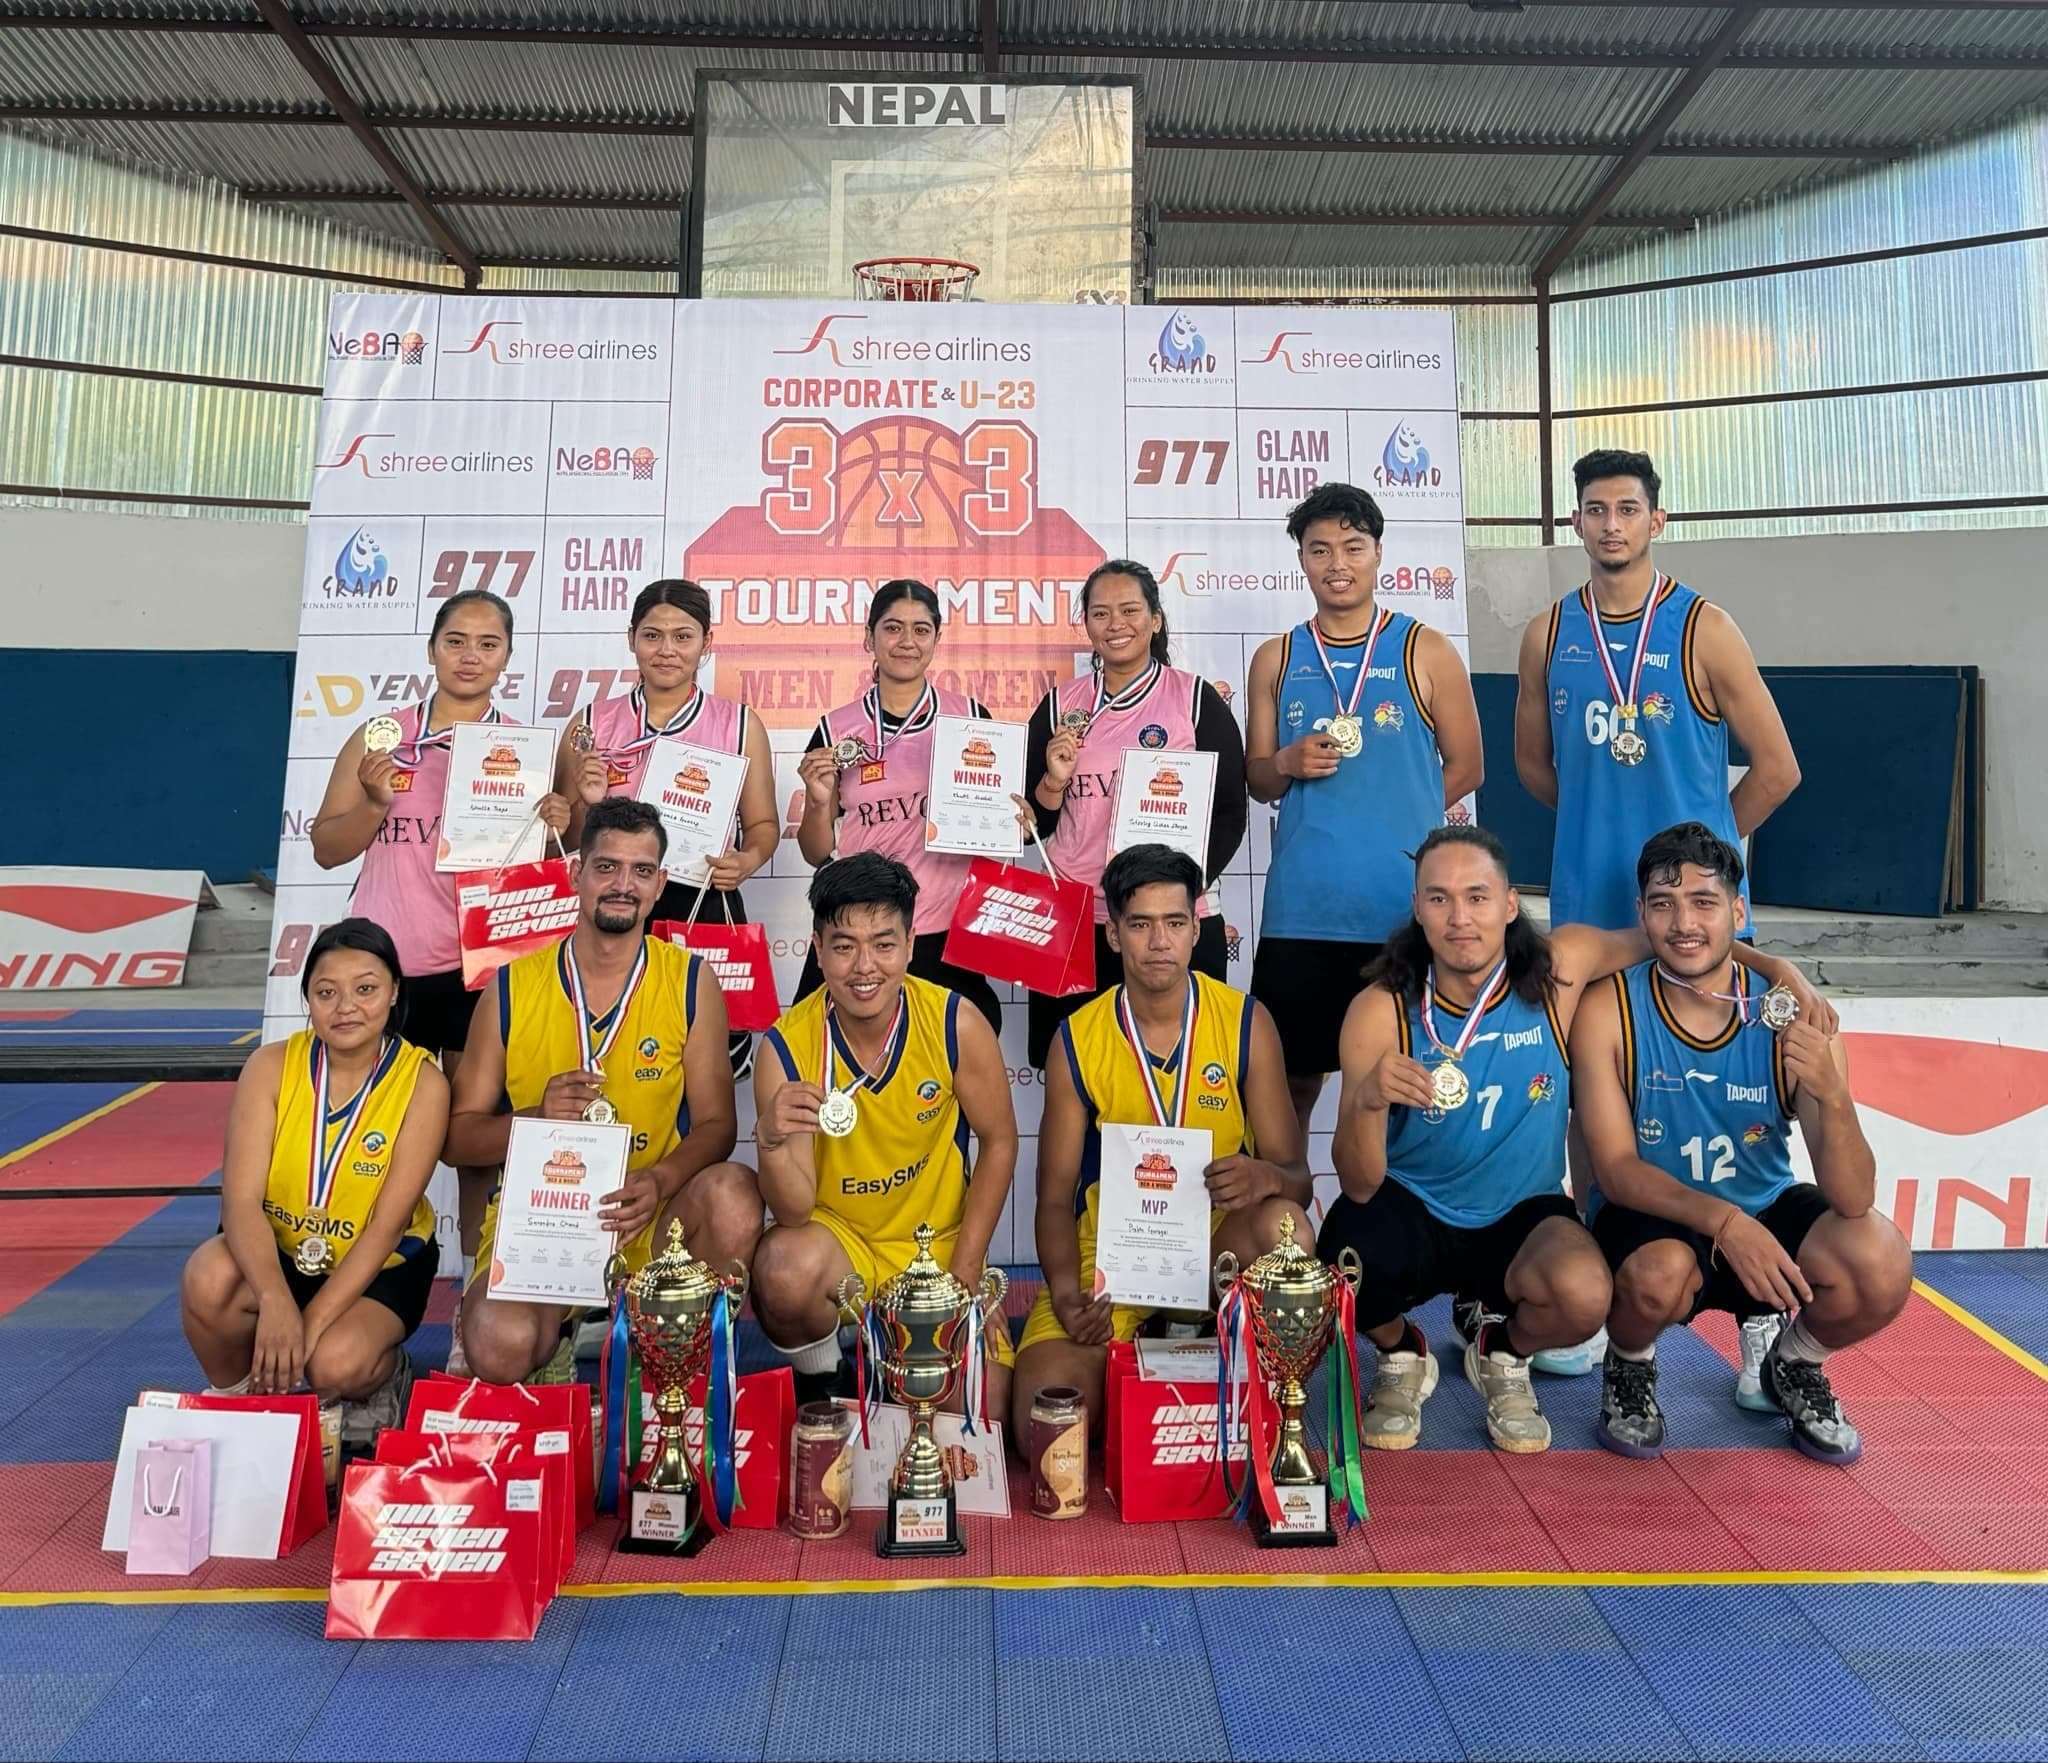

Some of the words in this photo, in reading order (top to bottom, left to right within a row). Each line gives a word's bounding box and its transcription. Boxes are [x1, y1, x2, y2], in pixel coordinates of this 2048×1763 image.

[829, 86, 1006, 125] NEPAL
[330, 332, 400, 355] NeBA
[763, 378, 938, 409] CORPORATE
[941, 387, 956, 401] &
[960, 380, 1036, 409] U-23
[1257, 429, 1329, 463] GLAM
[556, 447, 631, 471] NeBA
[1133, 439, 1230, 485] 977
[564, 537, 643, 572] GLAM
[427, 550, 536, 599] 977
[1375, 566, 1431, 590] eBA
[561, 577, 629, 611] HAIR
[699, 578, 1086, 626] TOURNMENT
[1643, 652, 1671, 670] POUT
[1366, 667, 1397, 681] APOUT
[740, 669, 834, 709] MEN
[925, 669, 1057, 709] OMEN
[472, 779, 525, 797] WINNER
[954, 769, 1002, 787] WINNER
[662, 790, 712, 814] WINNER
[1140, 799, 1188, 815] WINNER
[282, 810, 317, 835] Ne
[983, 885, 1042, 911] nine
[977, 900, 1058, 933] seven
[1504, 1025, 1543, 1051] TAPOUT
[635, 1067, 663, 1081] easy
[1198, 1094, 1229, 1111] easy
[1725, 1083, 1768, 1105] TAPOUT
[1477, 1085, 1503, 1131] 7
[353, 1160, 385, 1176] easy
[1680, 1135, 1736, 1183] 12
[841, 1153, 930, 1196] EasySMS
[530, 1189, 591, 1211] WINNER
[1141, 1199, 1168, 1215] MVP
[375, 1503, 474, 1525] nine
[924, 1506, 943, 1517] 977
[371, 1527, 509, 1551] seven
[641, 1529, 675, 1537] WINNER
[901, 1528, 944, 1538] WINNER
[368, 1551, 507, 1580] seven
